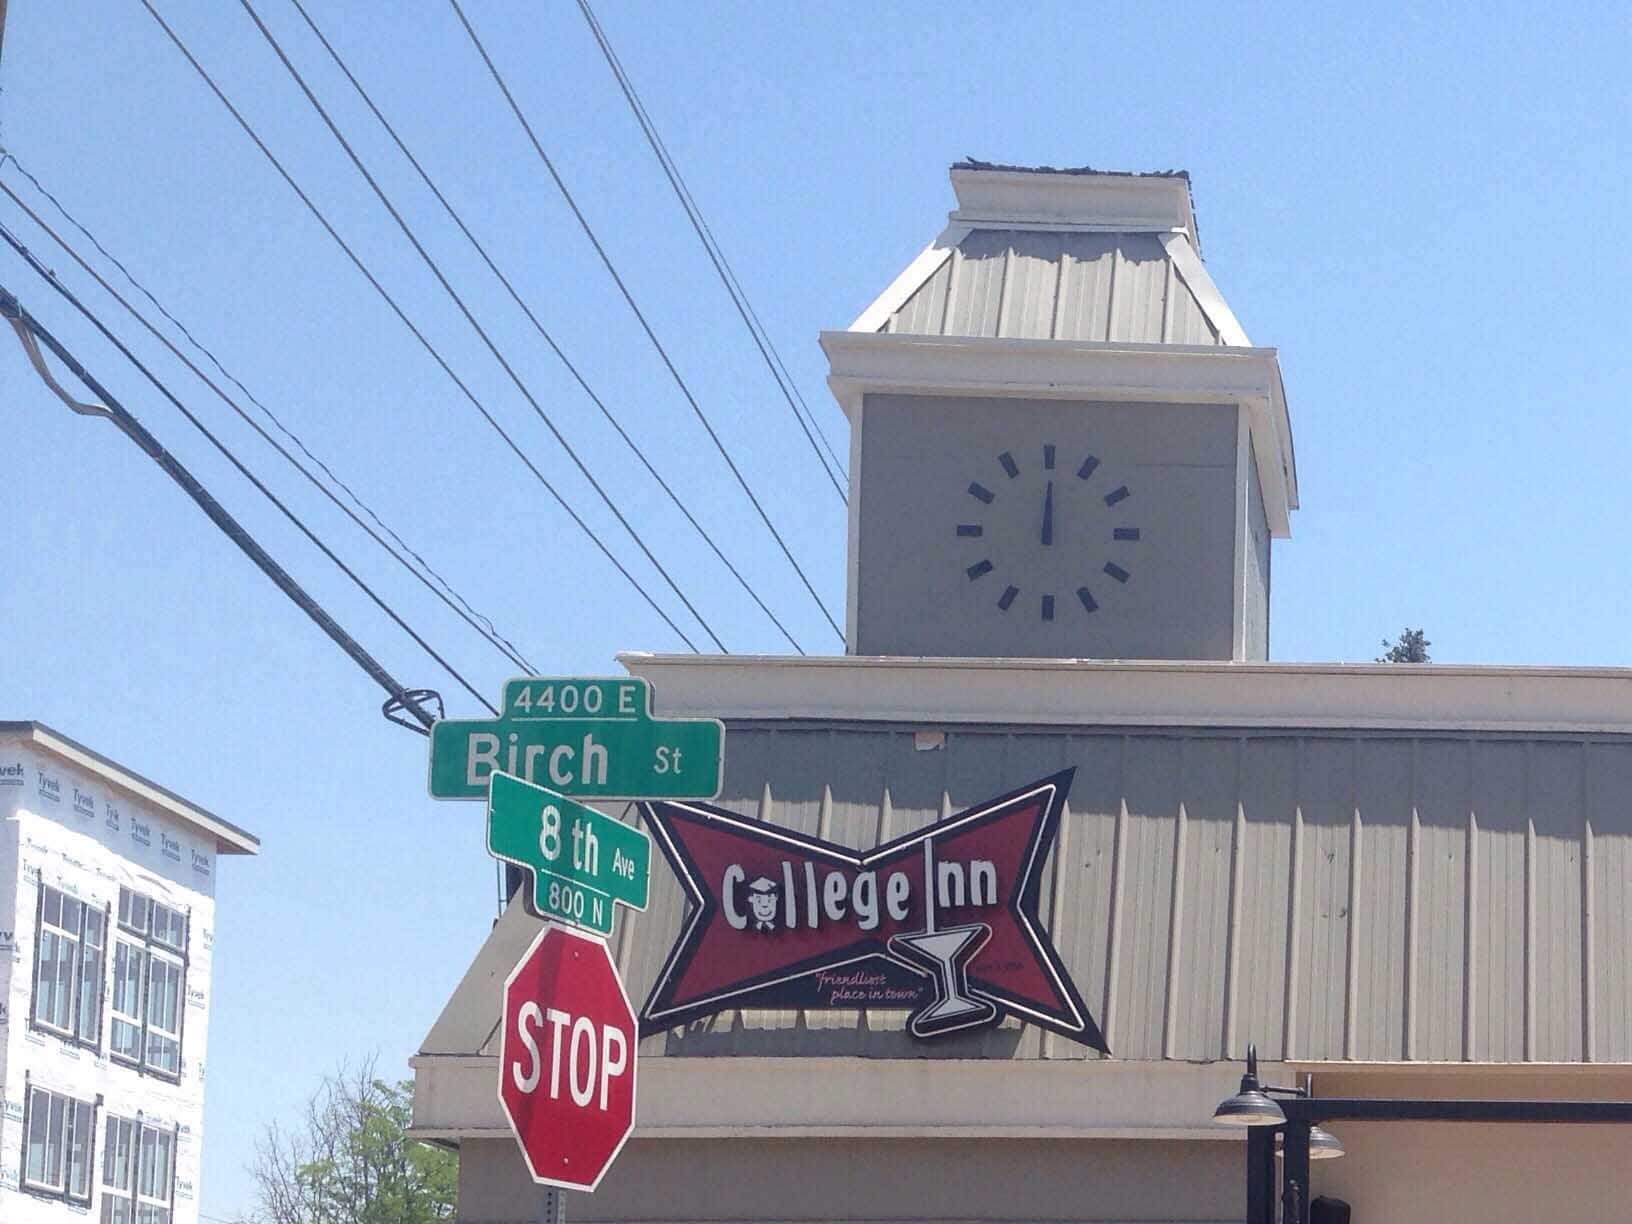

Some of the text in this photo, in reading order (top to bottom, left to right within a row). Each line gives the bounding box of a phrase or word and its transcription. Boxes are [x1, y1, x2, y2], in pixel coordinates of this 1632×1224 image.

[514, 685, 636, 713] 4400 E
[466, 733, 682, 786] Birch St
[538, 805, 635, 881] 8th Ave
[549, 881, 603, 926] 800 N
[924, 837, 998, 934] Inn
[512, 1001, 628, 1112] STOP
